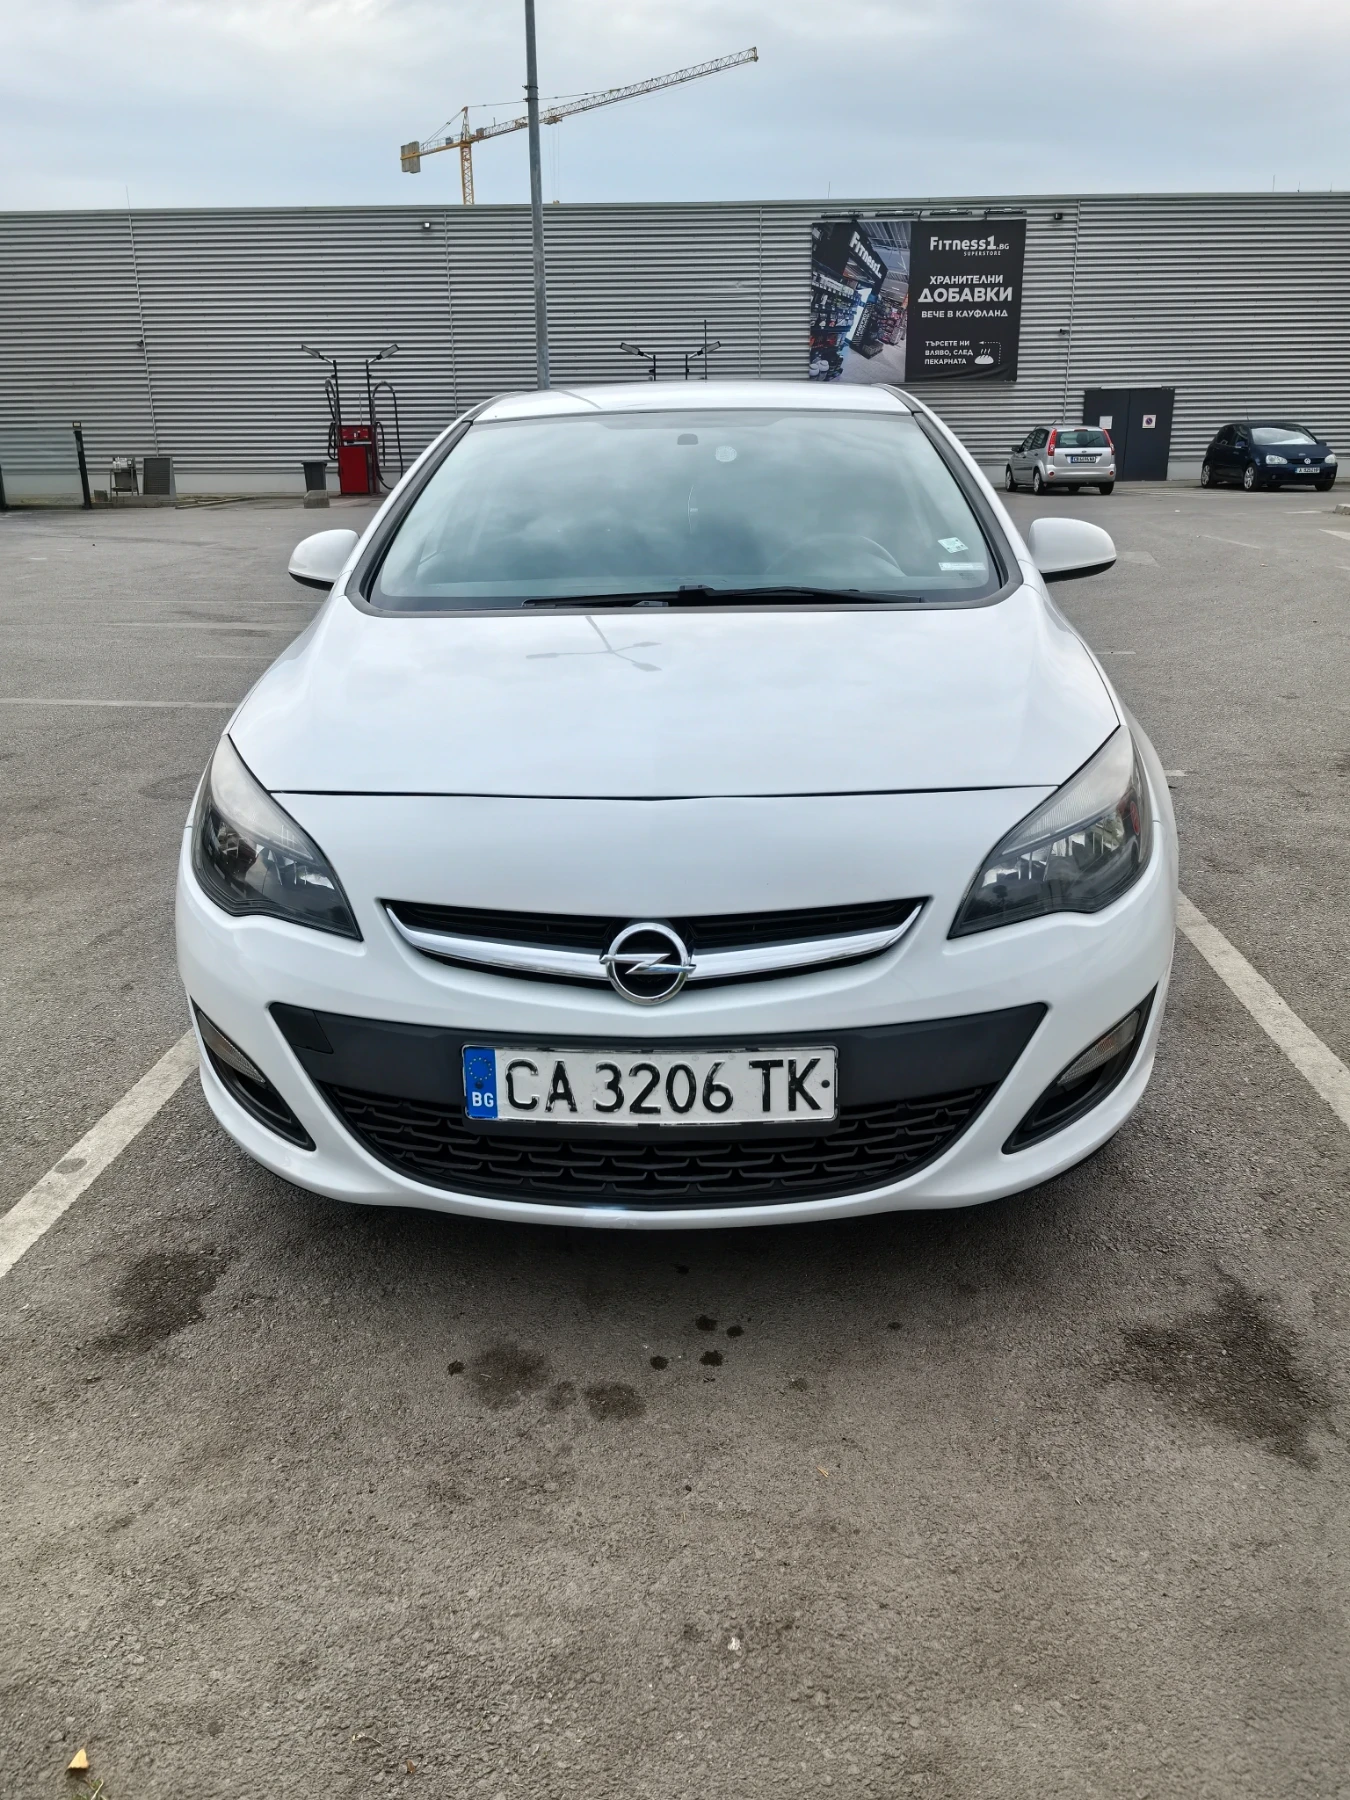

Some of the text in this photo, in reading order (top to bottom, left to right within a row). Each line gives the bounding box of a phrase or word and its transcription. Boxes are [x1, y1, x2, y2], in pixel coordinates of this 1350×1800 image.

[929, 275, 1004, 285] ХРАНИТЕЛНИ
[917, 287, 1013, 303] ДОБАВКИ
[921, 309, 1008, 318] ВЕЧЕ В КАУФЛАНД
[471, 1058, 821, 1114] BG CA 3206 TK
